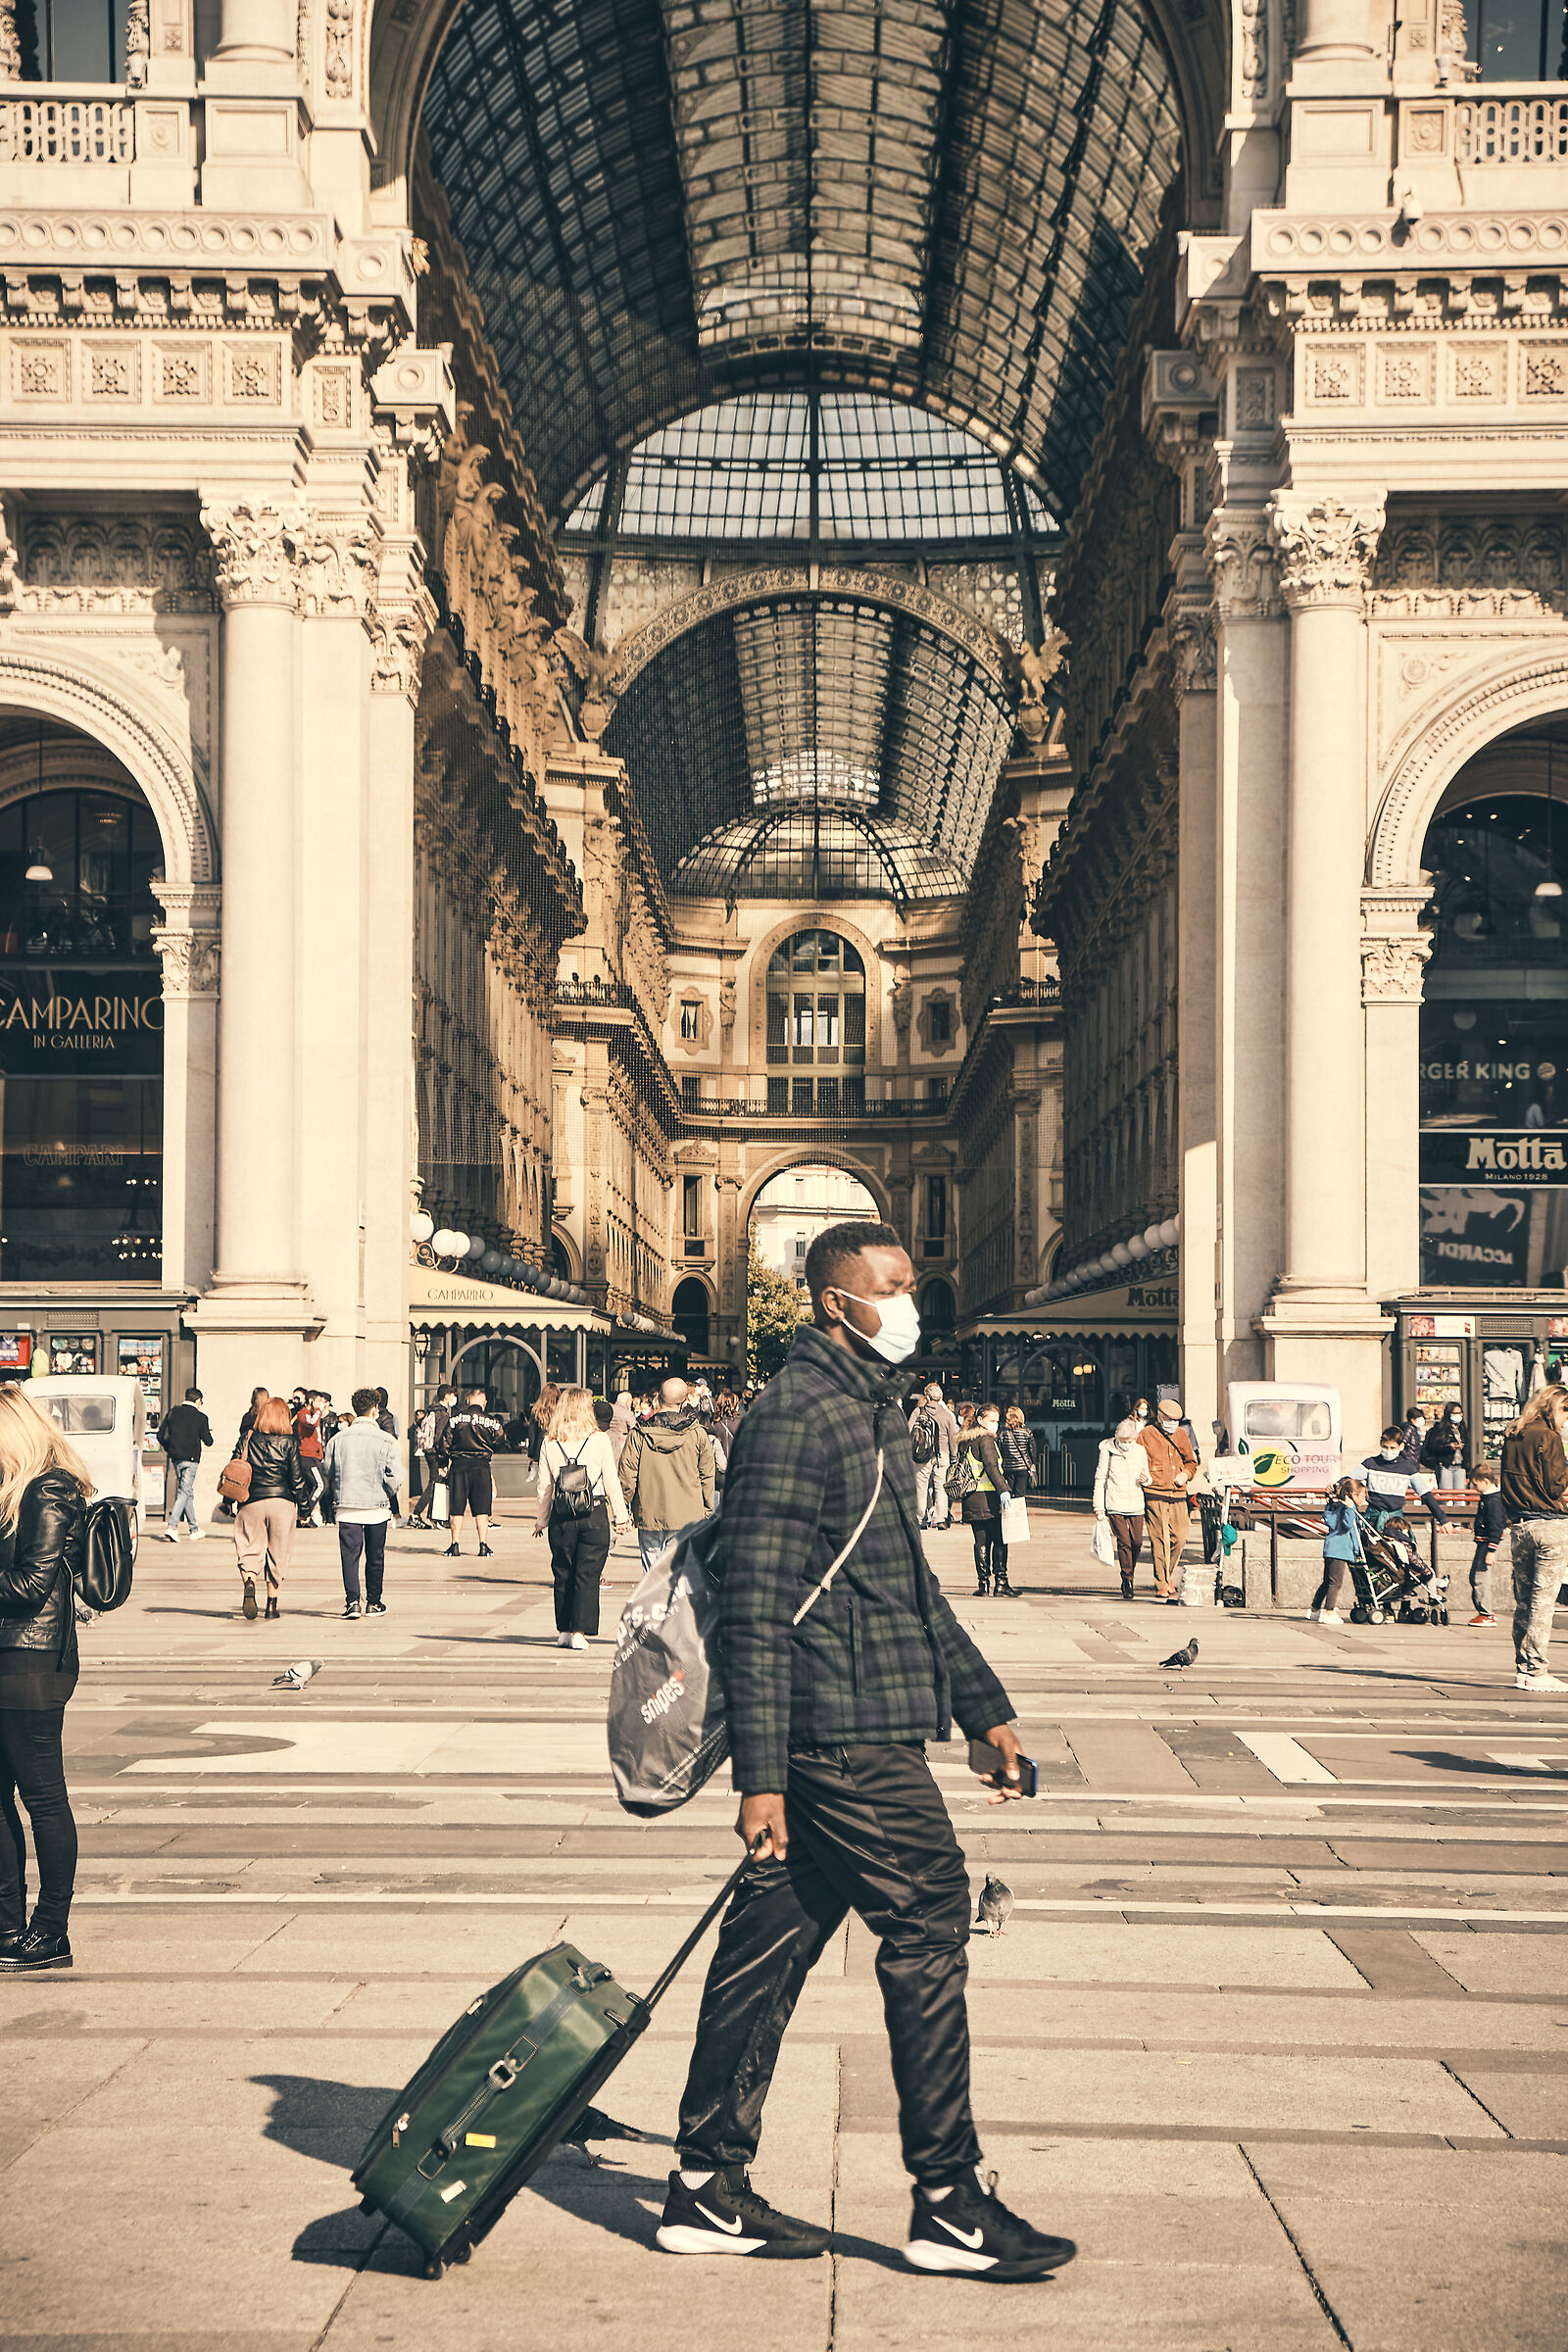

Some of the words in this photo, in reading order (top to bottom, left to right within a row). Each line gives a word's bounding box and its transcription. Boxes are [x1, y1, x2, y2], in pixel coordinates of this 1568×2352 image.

[33, 1035, 46, 1049] IN
[50, 1035, 115, 1049] GALLERIA
[1475, 1062, 1531, 1080] KING
[23, 1144, 123, 1167] CAMPARI
[1465, 1137, 1568, 1170] Motta
[427, 1288, 494, 1300] CAMPARINO
[1275, 1454, 1300, 1465] ECO
[1280, 1465, 1330, 1474] SHOPPING
[640, 1676, 685, 1725] snipes
